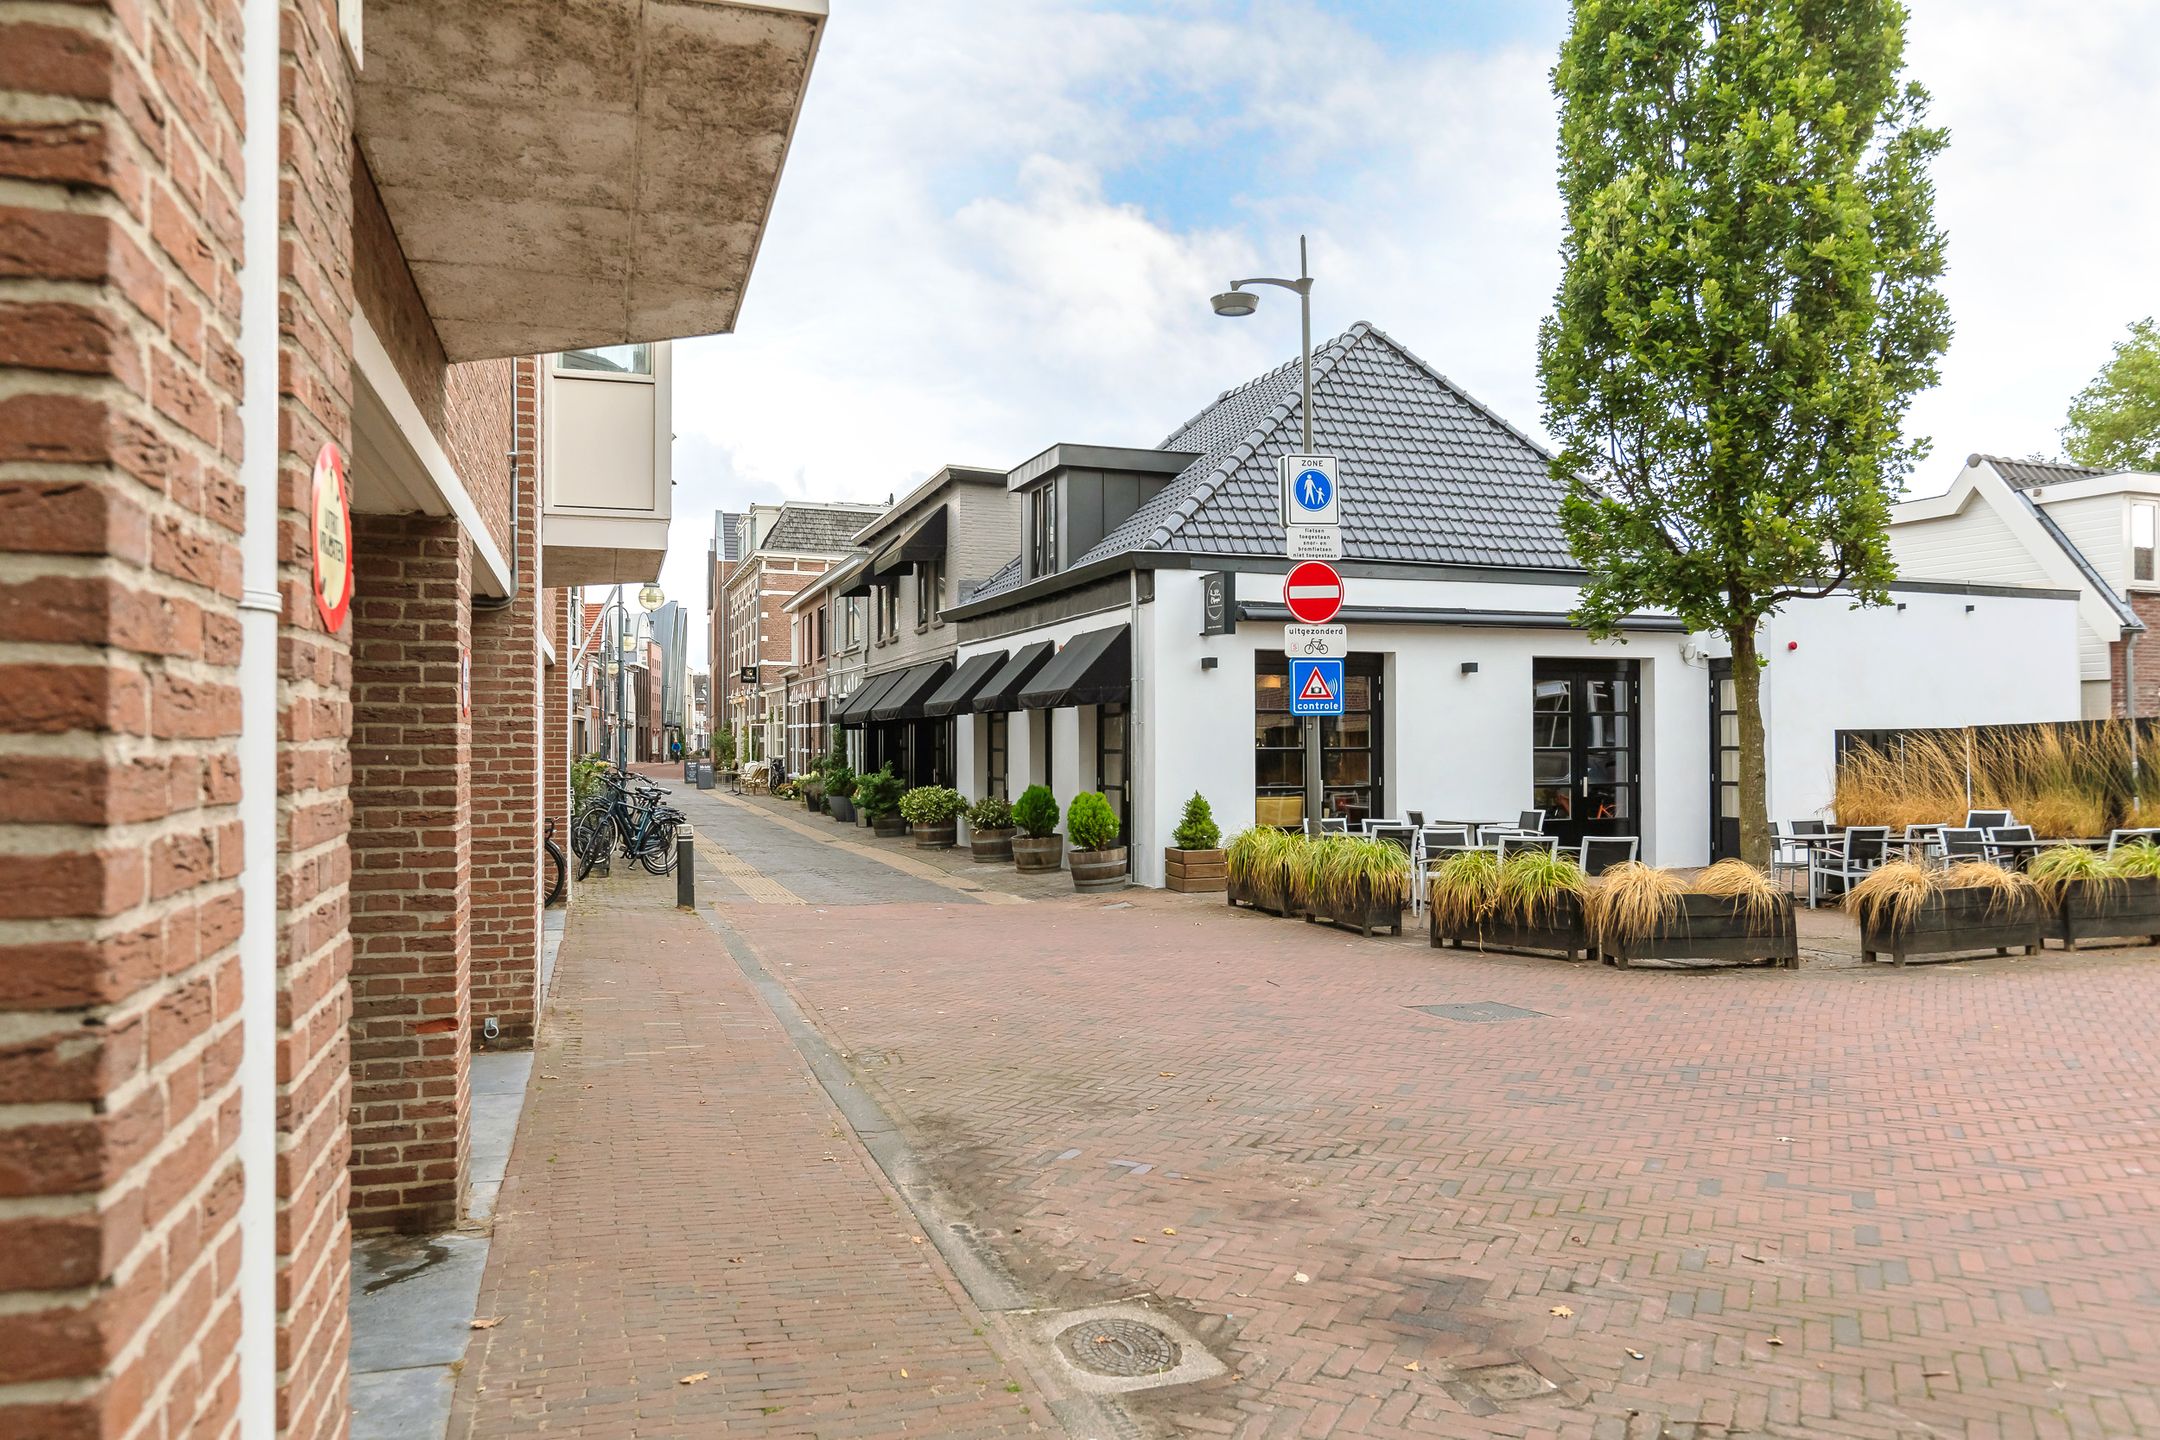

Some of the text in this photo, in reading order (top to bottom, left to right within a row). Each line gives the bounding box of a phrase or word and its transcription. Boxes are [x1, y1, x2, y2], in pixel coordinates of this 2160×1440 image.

[1301, 459, 1324, 467] ZONE
[1289, 628, 1343, 636] uitgezonderd
[1297, 702, 1339, 710] controle
